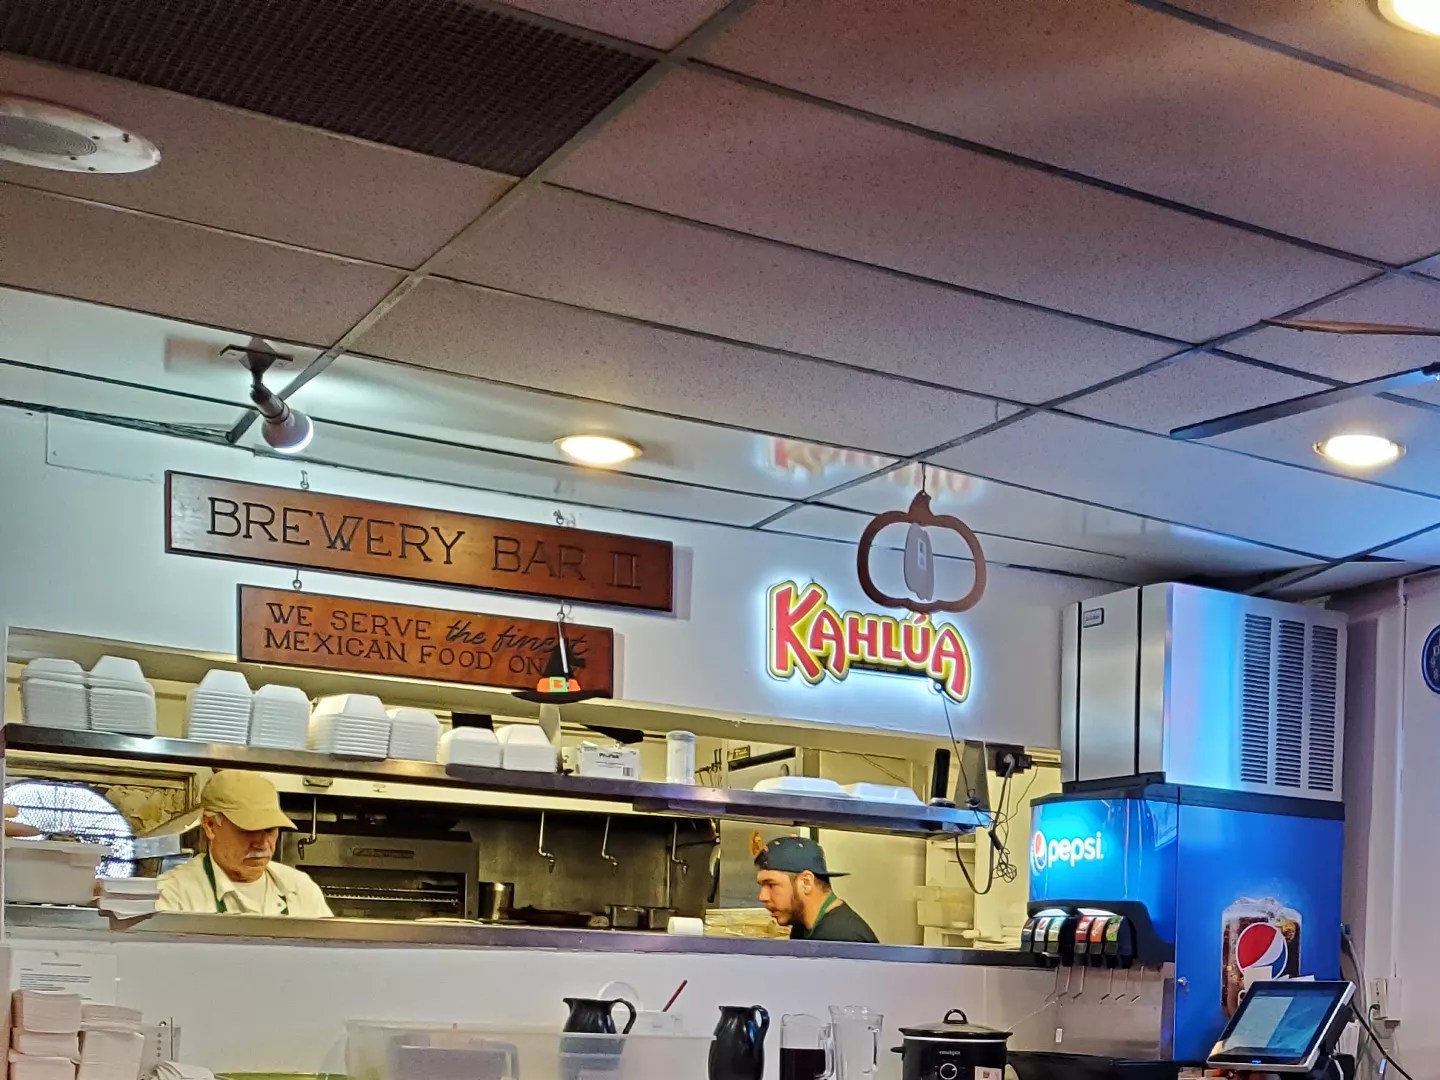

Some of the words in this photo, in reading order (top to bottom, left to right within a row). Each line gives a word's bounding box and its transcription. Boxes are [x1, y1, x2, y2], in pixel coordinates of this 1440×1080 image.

[206, 496, 466, 567] BREWERY
[492, 535, 587, 582] BAR
[606, 549, 642, 590] II
[263, 627, 407, 663] MEXICAN
[418, 645, 495, 672] FOOD
[265, 602, 312, 628] WE
[331, 609, 431, 642] SERVE
[446, 619, 487, 646] the
[491, 625, 590, 655] finet
[770, 580, 970, 700] KAHLÚA
[1047, 832, 1103, 868] pepsi
